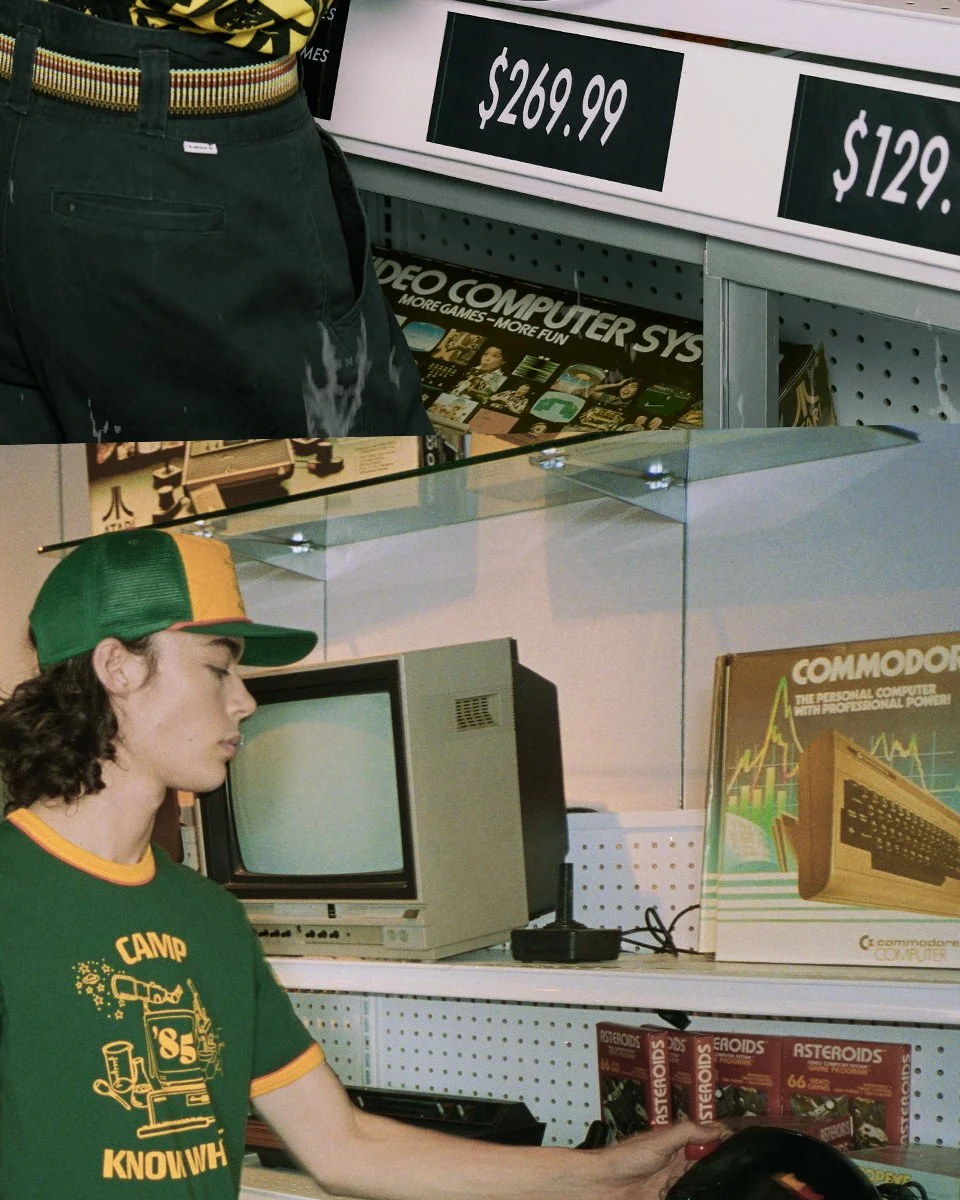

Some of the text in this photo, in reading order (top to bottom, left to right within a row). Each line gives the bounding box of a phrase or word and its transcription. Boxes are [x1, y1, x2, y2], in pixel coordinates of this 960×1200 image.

[478, 46, 628, 147] $269.99
[398, 293, 442, 313] MORE
[539, 327, 570, 346] FUN
[448, 279, 636, 349] COMPUTER
[793, 705, 821, 717] WITH
[822, 697, 904, 715] PROFESSIONAL
[794, 683, 937, 705] THE PERSONAL COMPUTER
[115, 931, 188, 966] CAMP
[873, 948, 947, 962] COMPUTER
[152, 1025, 197, 1065] '85
[600, 1030, 640, 1048] ASTEROIDS
[793, 1043, 882, 1064] ASTEROIDS
[651, 1038, 669, 1125] ASTEROIDS
[787, 1074, 806, 1089] 66
[900, 1053, 910, 1145] ASTEROIDS
